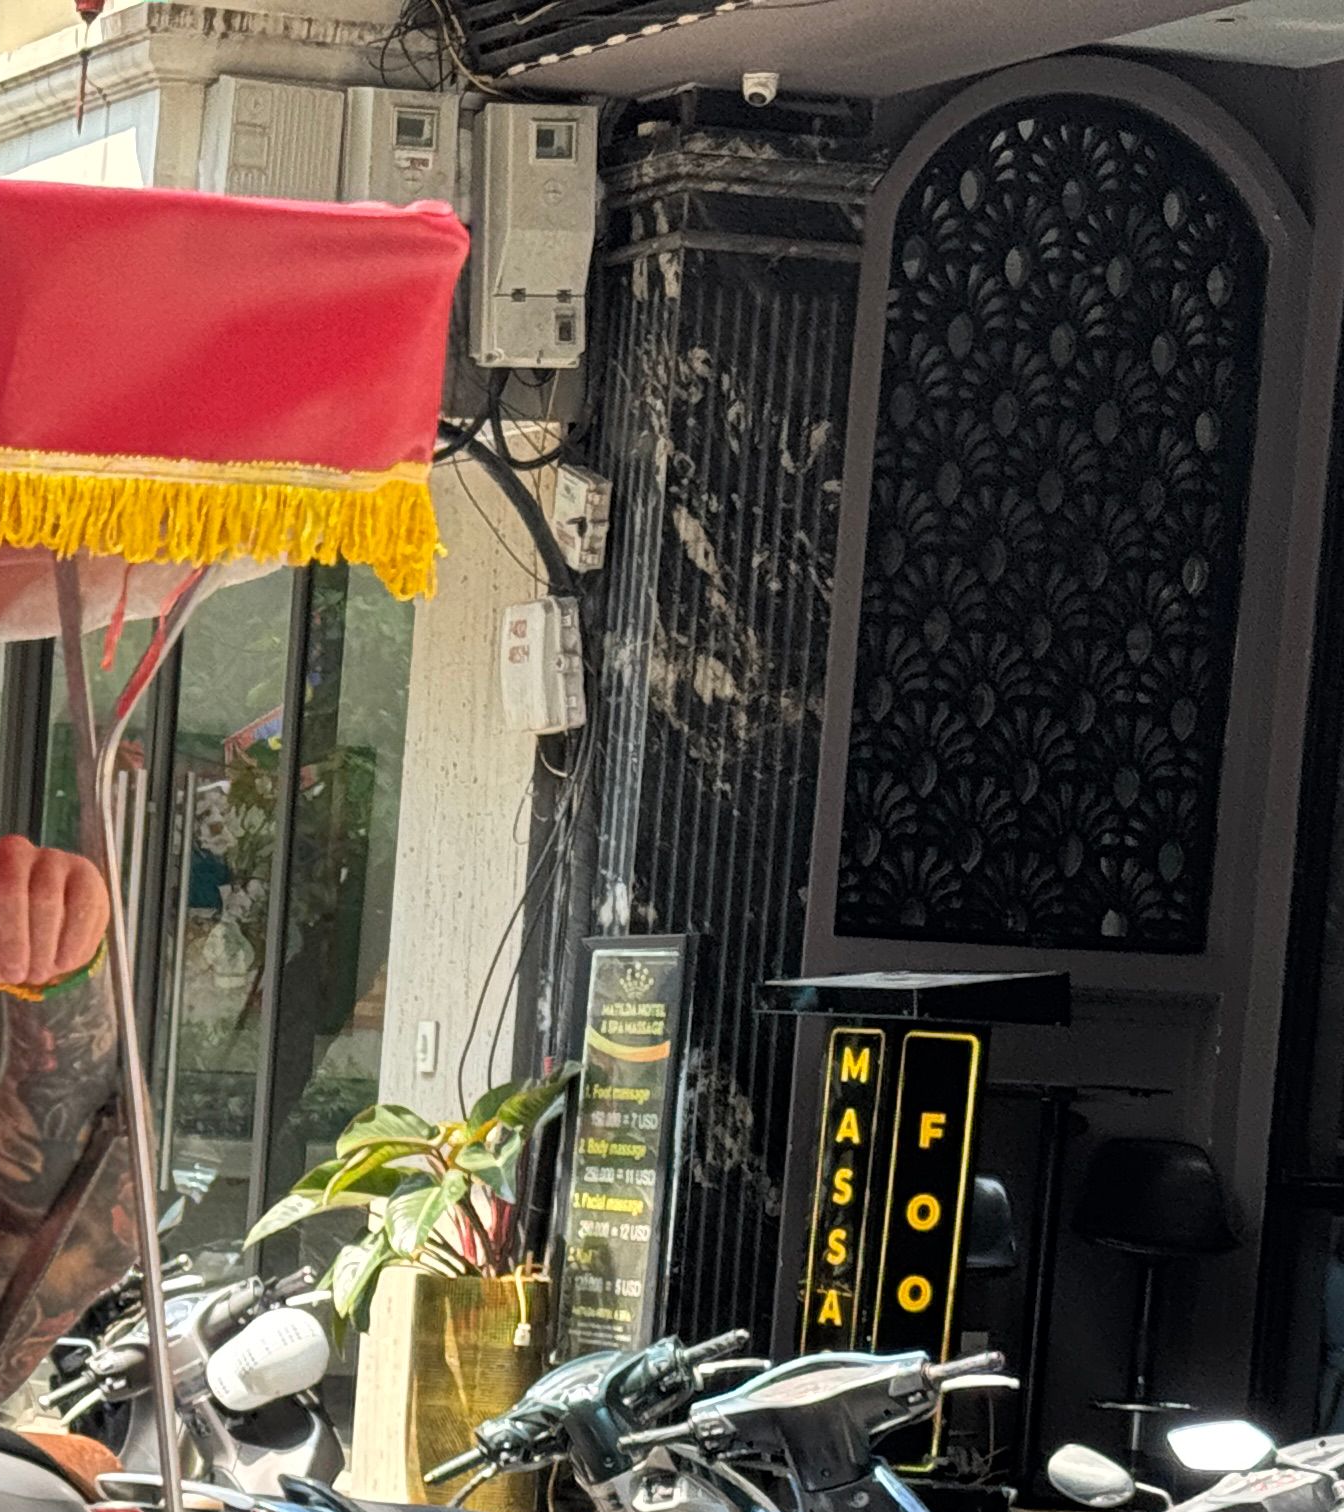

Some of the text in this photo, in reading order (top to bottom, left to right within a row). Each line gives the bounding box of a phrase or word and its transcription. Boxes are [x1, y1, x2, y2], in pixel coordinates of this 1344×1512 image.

[638, 1113, 658, 1130] USD
[586, 1137, 609, 1159] Body
[609, 1143, 647, 1160] massage
[635, 1169, 657, 1186] USD
[606, 1197, 644, 1217] massage
[817, 1045, 872, 1353] MASSA
[630, 1224, 652, 1242] USD
[622, 1279, 642, 1298] USD
